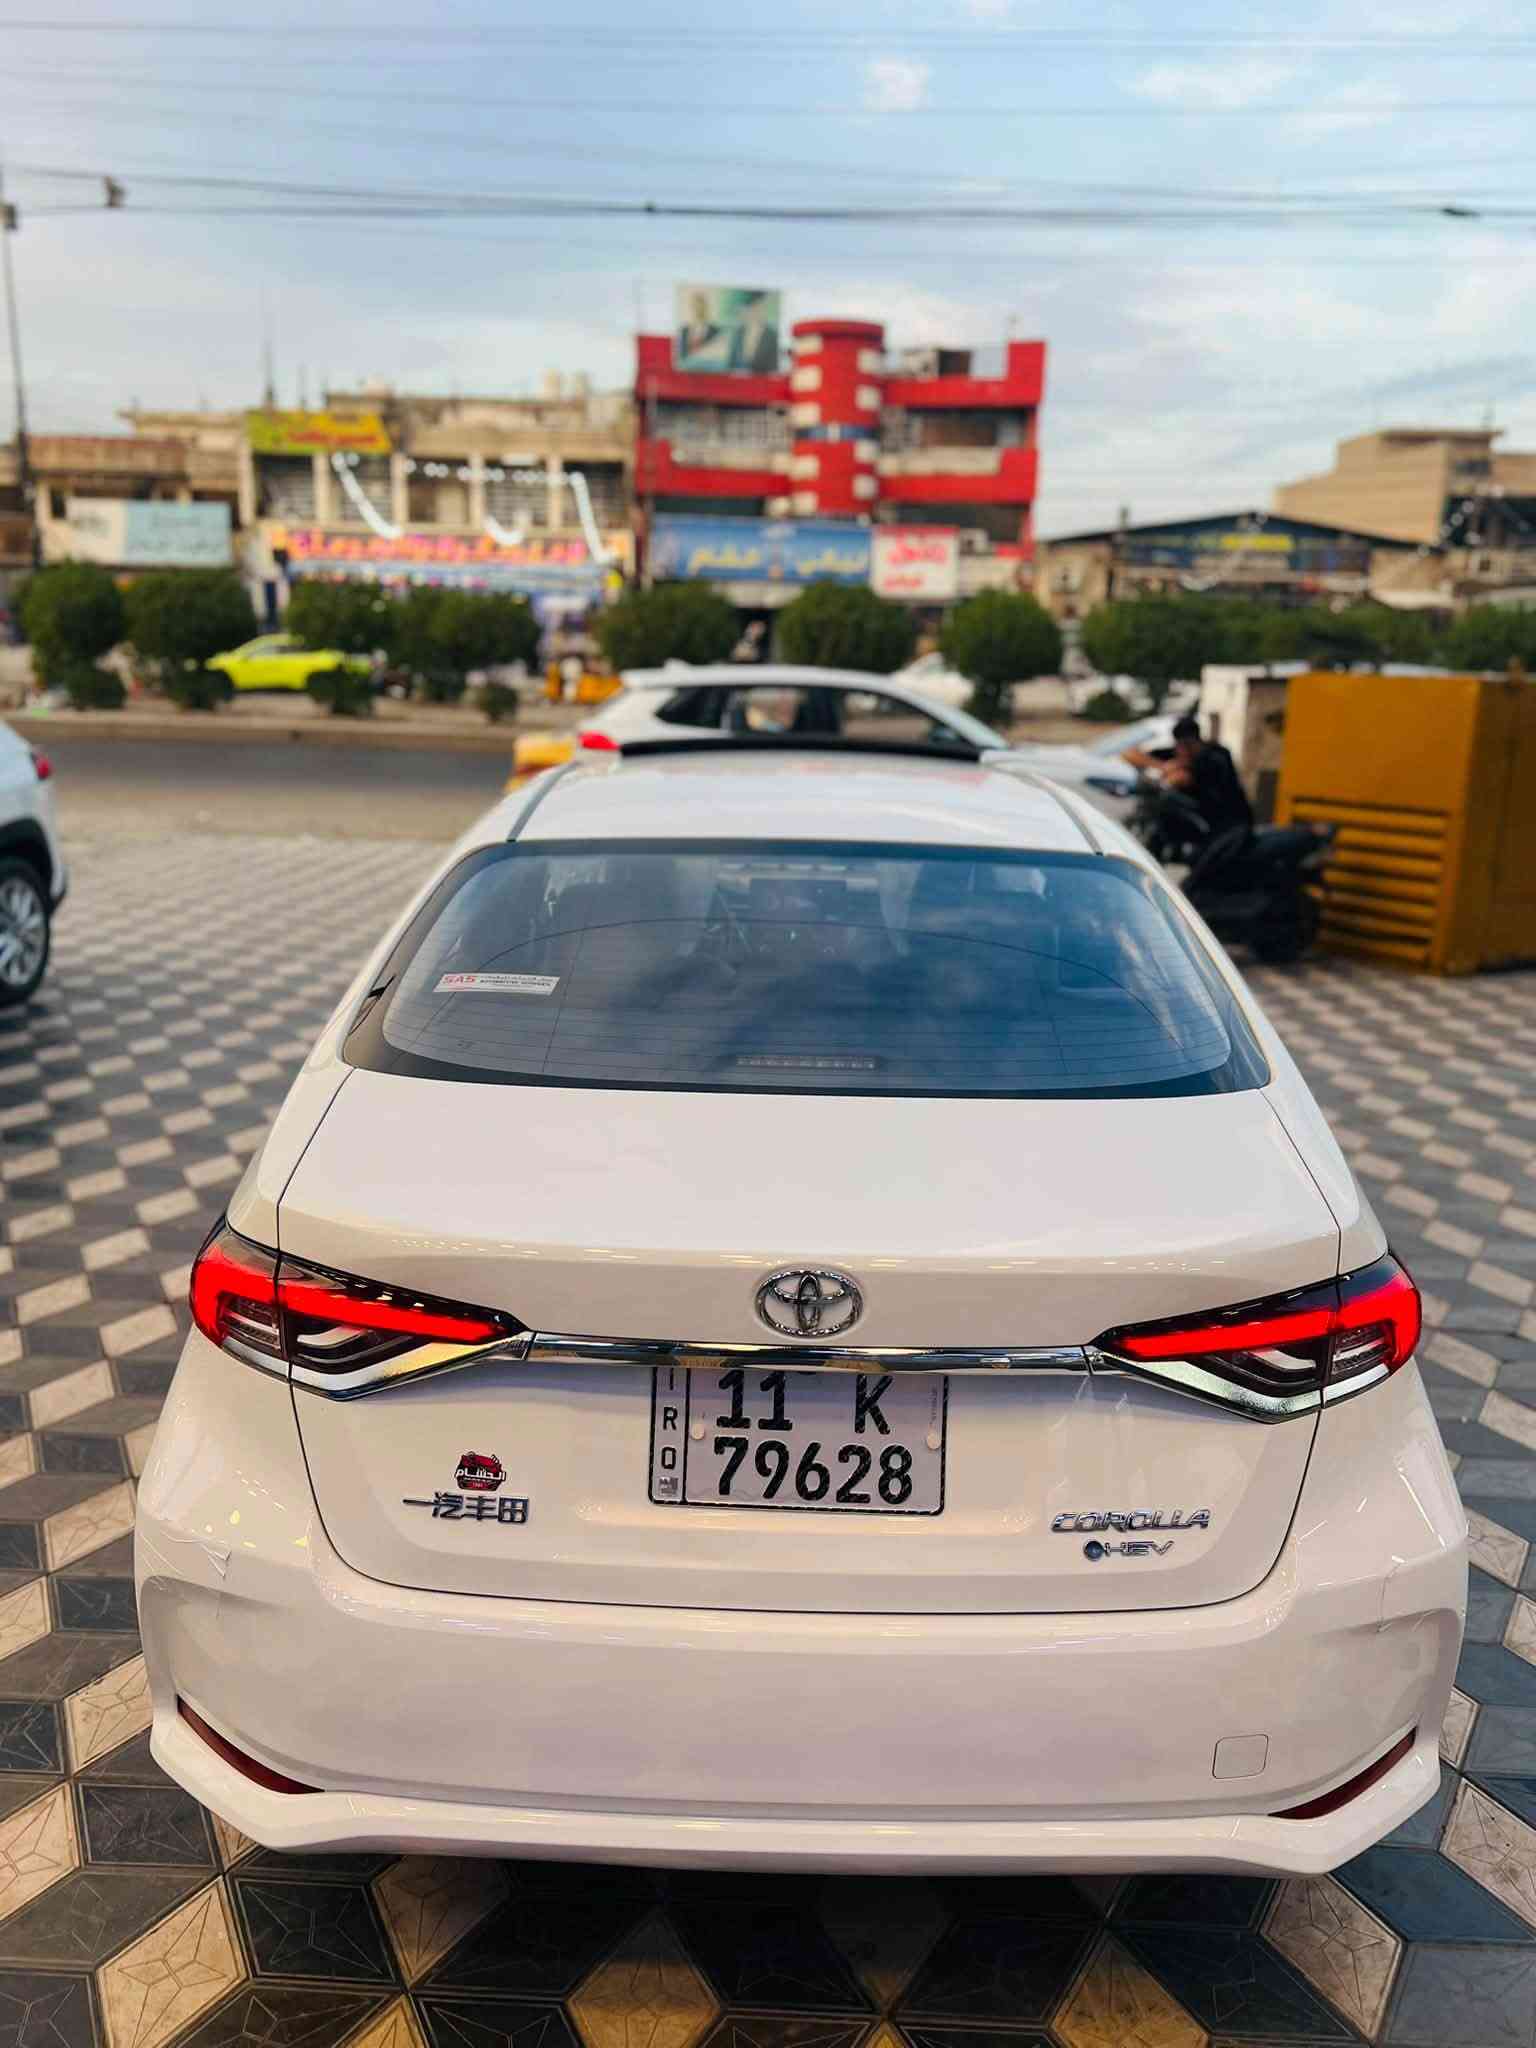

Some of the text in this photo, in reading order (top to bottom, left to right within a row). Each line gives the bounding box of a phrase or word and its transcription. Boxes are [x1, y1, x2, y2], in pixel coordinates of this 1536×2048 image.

[716, 1369, 793, 1431] 11
[854, 1375, 891, 1435] K
[714, 1437, 912, 1504] 79628
[402, 1492, 529, 1523] 一汽丰田
[1051, 1509, 1210, 1532] COROLLA
[1104, 1540, 1174, 1556] HEV
